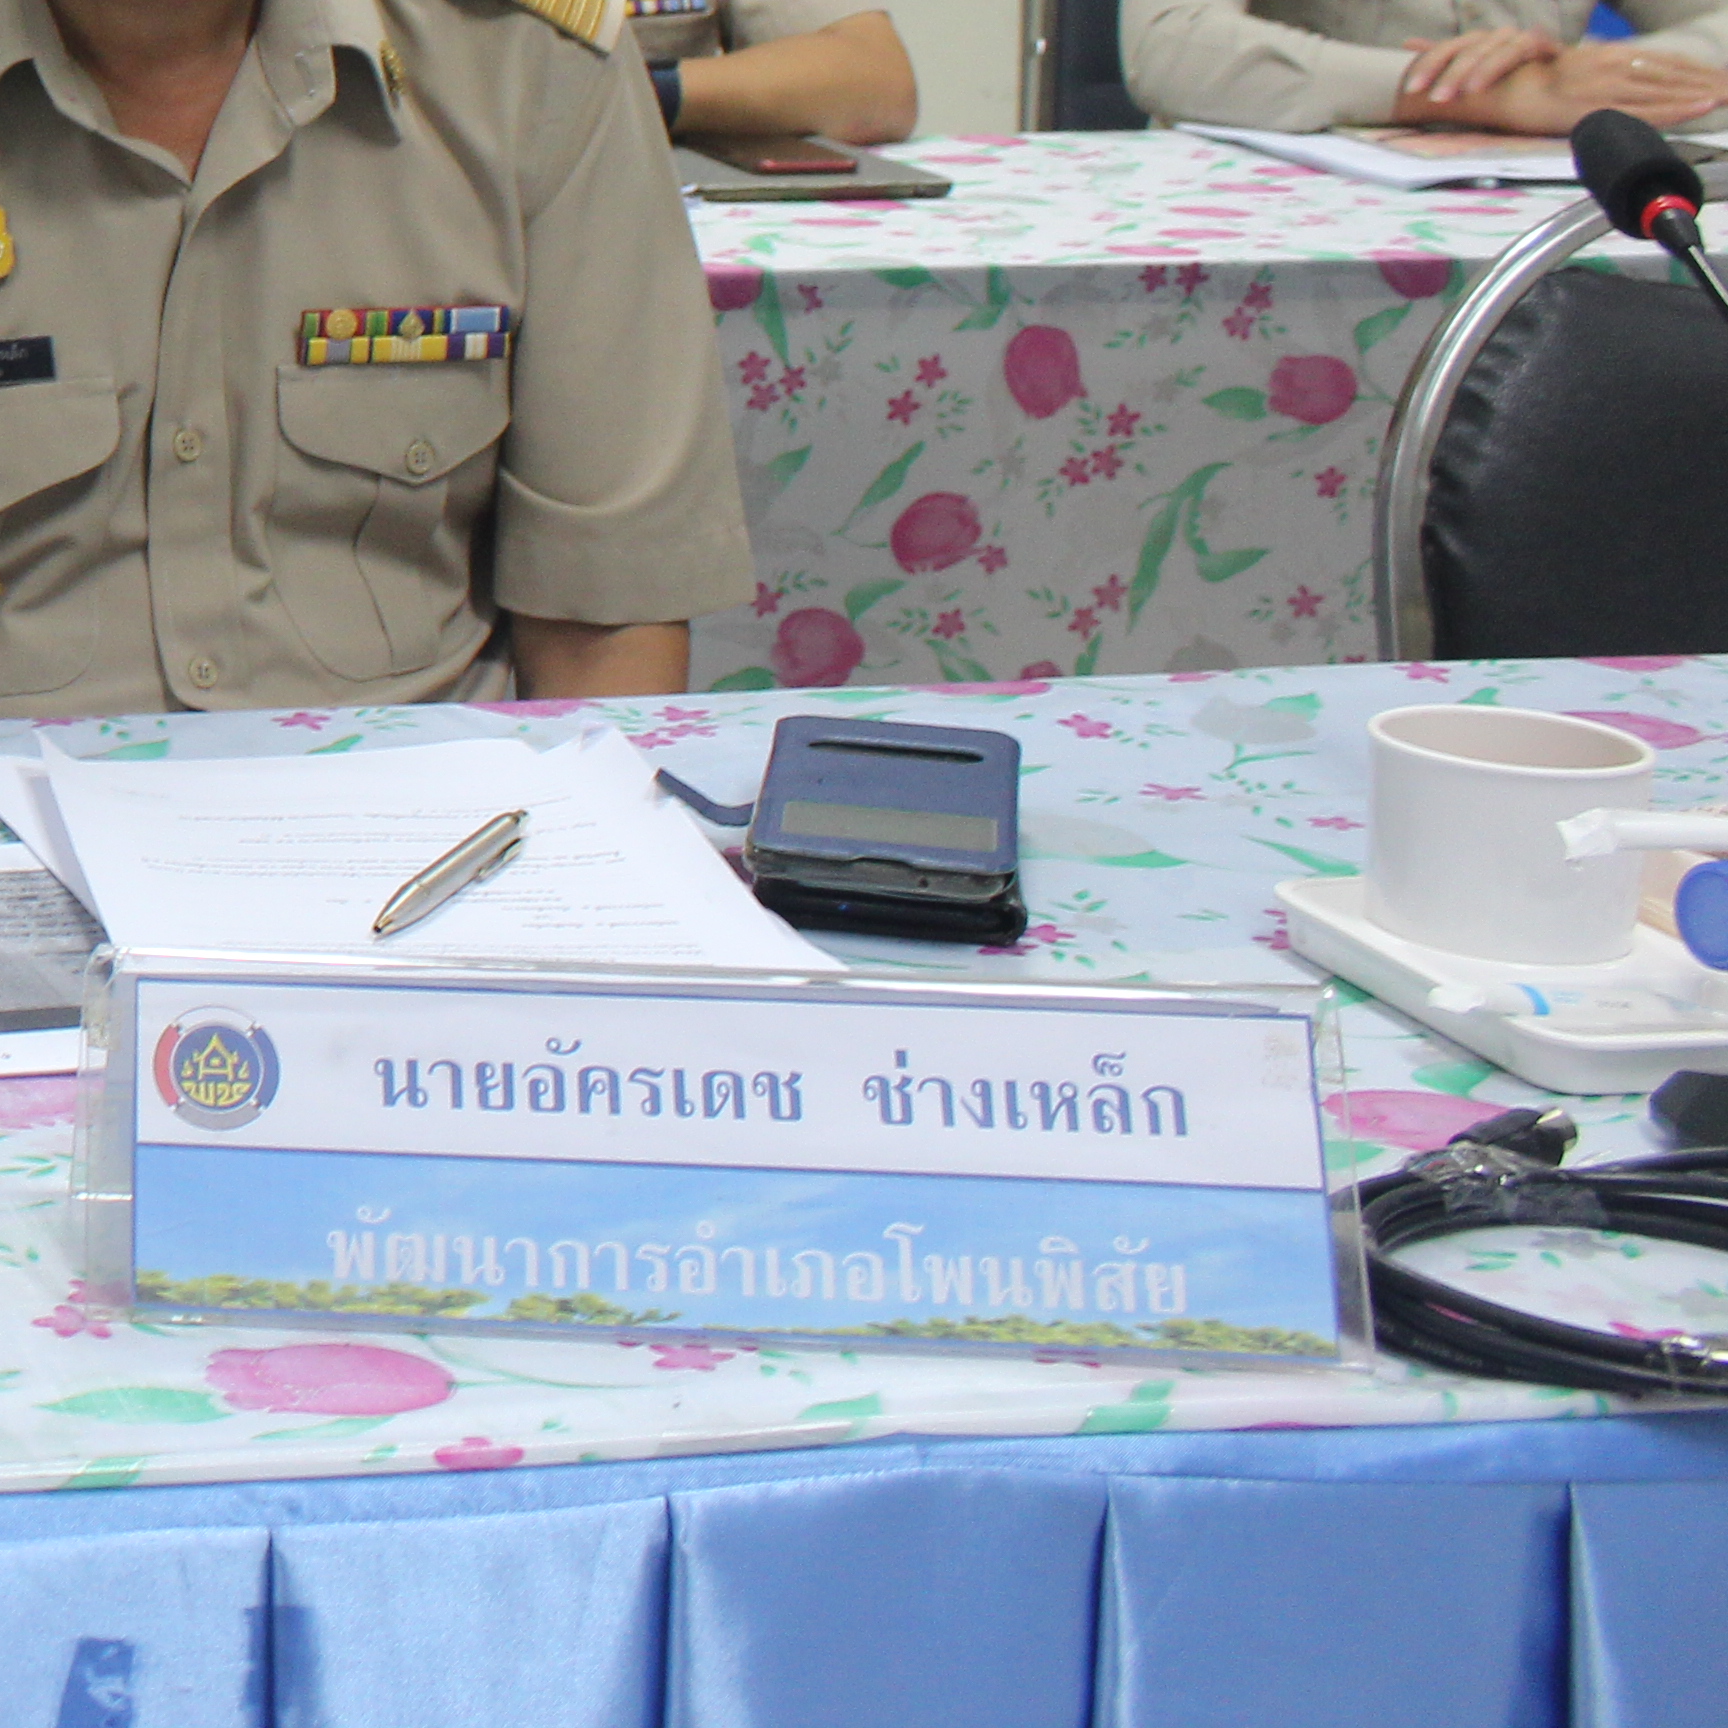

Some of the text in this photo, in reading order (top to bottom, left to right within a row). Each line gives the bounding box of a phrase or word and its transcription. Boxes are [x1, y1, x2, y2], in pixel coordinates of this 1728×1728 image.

[373, 1036, 1189, 1138] นายอัครเดช ช่างเหล็ก
[326, 1204, 1188, 1315] พัฒนาการอำเภอโพนพิสัย
